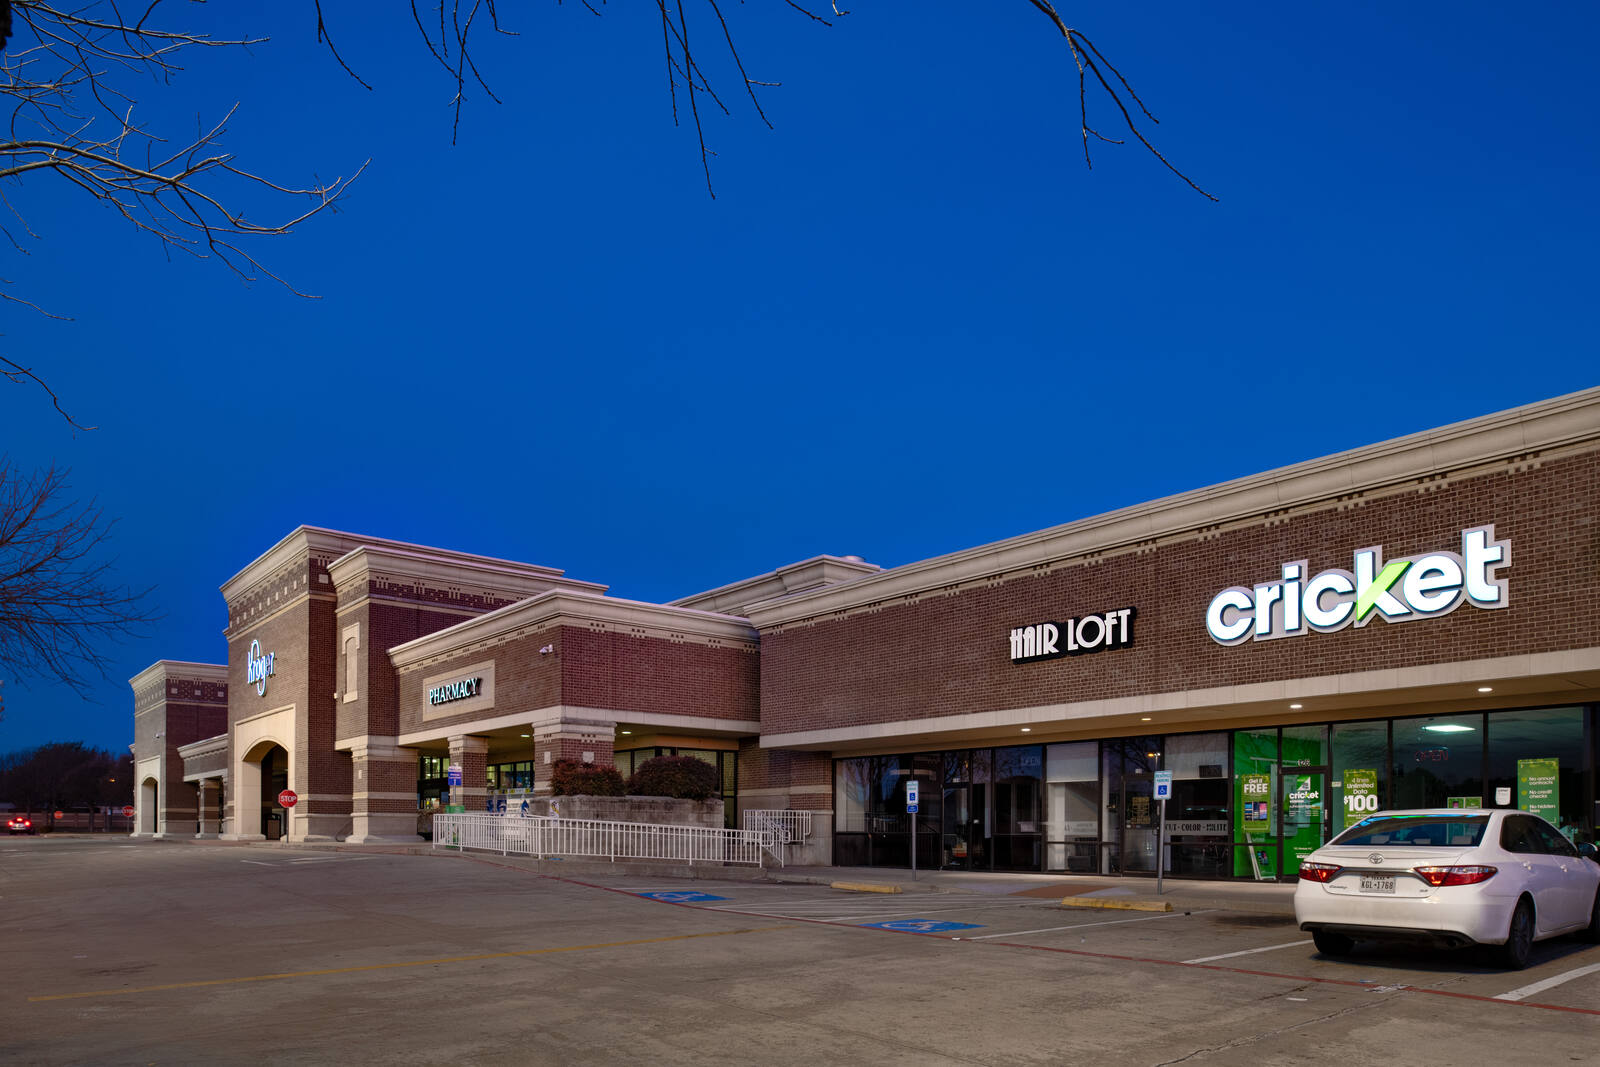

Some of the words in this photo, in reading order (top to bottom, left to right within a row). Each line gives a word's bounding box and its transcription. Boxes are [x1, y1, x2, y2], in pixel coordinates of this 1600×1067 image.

[1206, 528, 1504, 643] cricket
[1010, 623, 1059, 660] HAIR
[1068, 609, 1131, 651] LOFT
[247, 639, 275, 697] Kroger
[429, 677, 479, 705] PHARMACY
[1244, 783, 1268, 793] FREE
[1289, 791, 1320, 800] cricket
[1344, 794, 1378, 812] $100
[1182, 823, 1201, 832] COLOR
